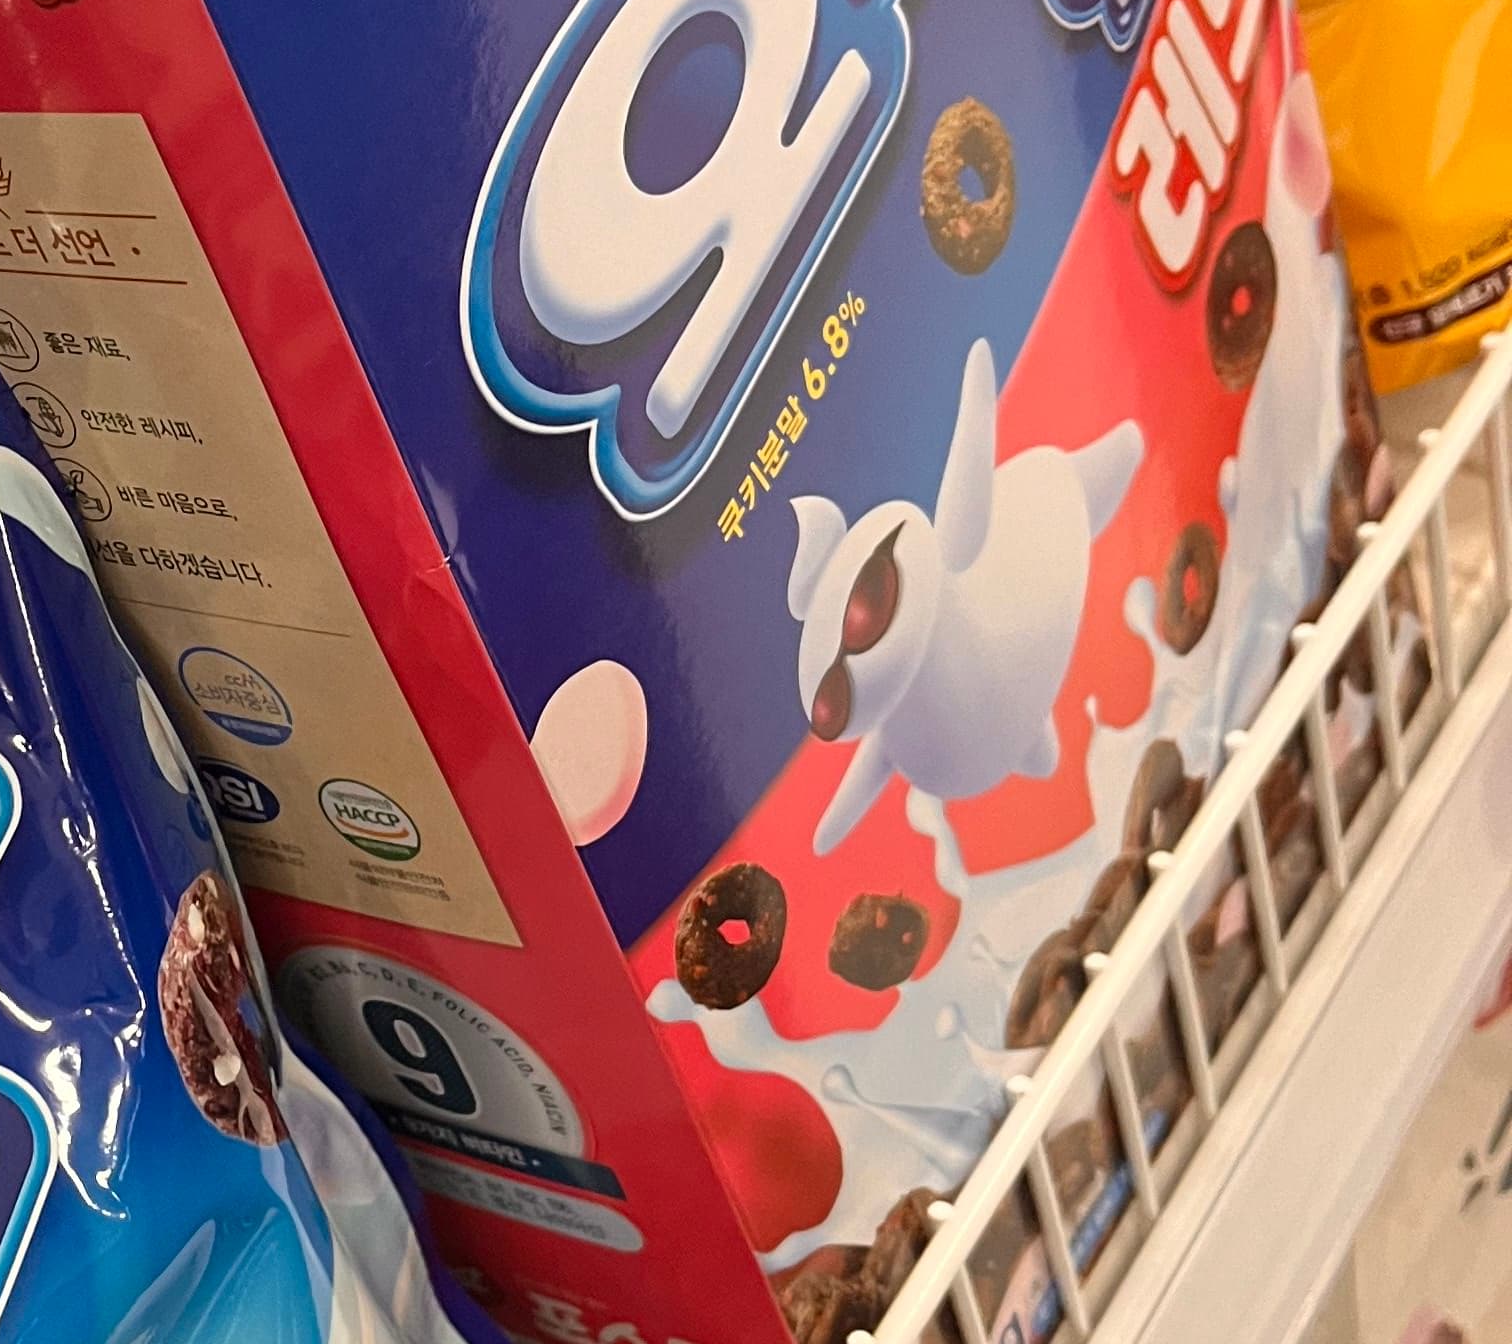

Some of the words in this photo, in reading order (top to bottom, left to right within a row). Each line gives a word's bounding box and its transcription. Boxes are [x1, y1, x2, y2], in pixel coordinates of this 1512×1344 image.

[16, 224, 48, 263] 더
[50, 228, 115, 267] 선언
[44, 331, 82, 355] 좋은
[83, 335, 131, 362] 재료,
[80, 409, 136, 436] 안전한
[139, 417, 204, 445] 레시피,
[717, 394, 810, 543] 쿠키분말
[803, 290, 867, 399] 6.8%
[116, 485, 154, 510] 바른
[155, 489, 238, 522] 마음으로,
[138, 547, 272, 589] 다하겠습니다.
[333, 800, 401, 831] HACCP
[362, 999, 478, 1116] 9
[432, 990, 489, 1034] FOLIC
[533, 1081, 569, 1137] NIACIN
